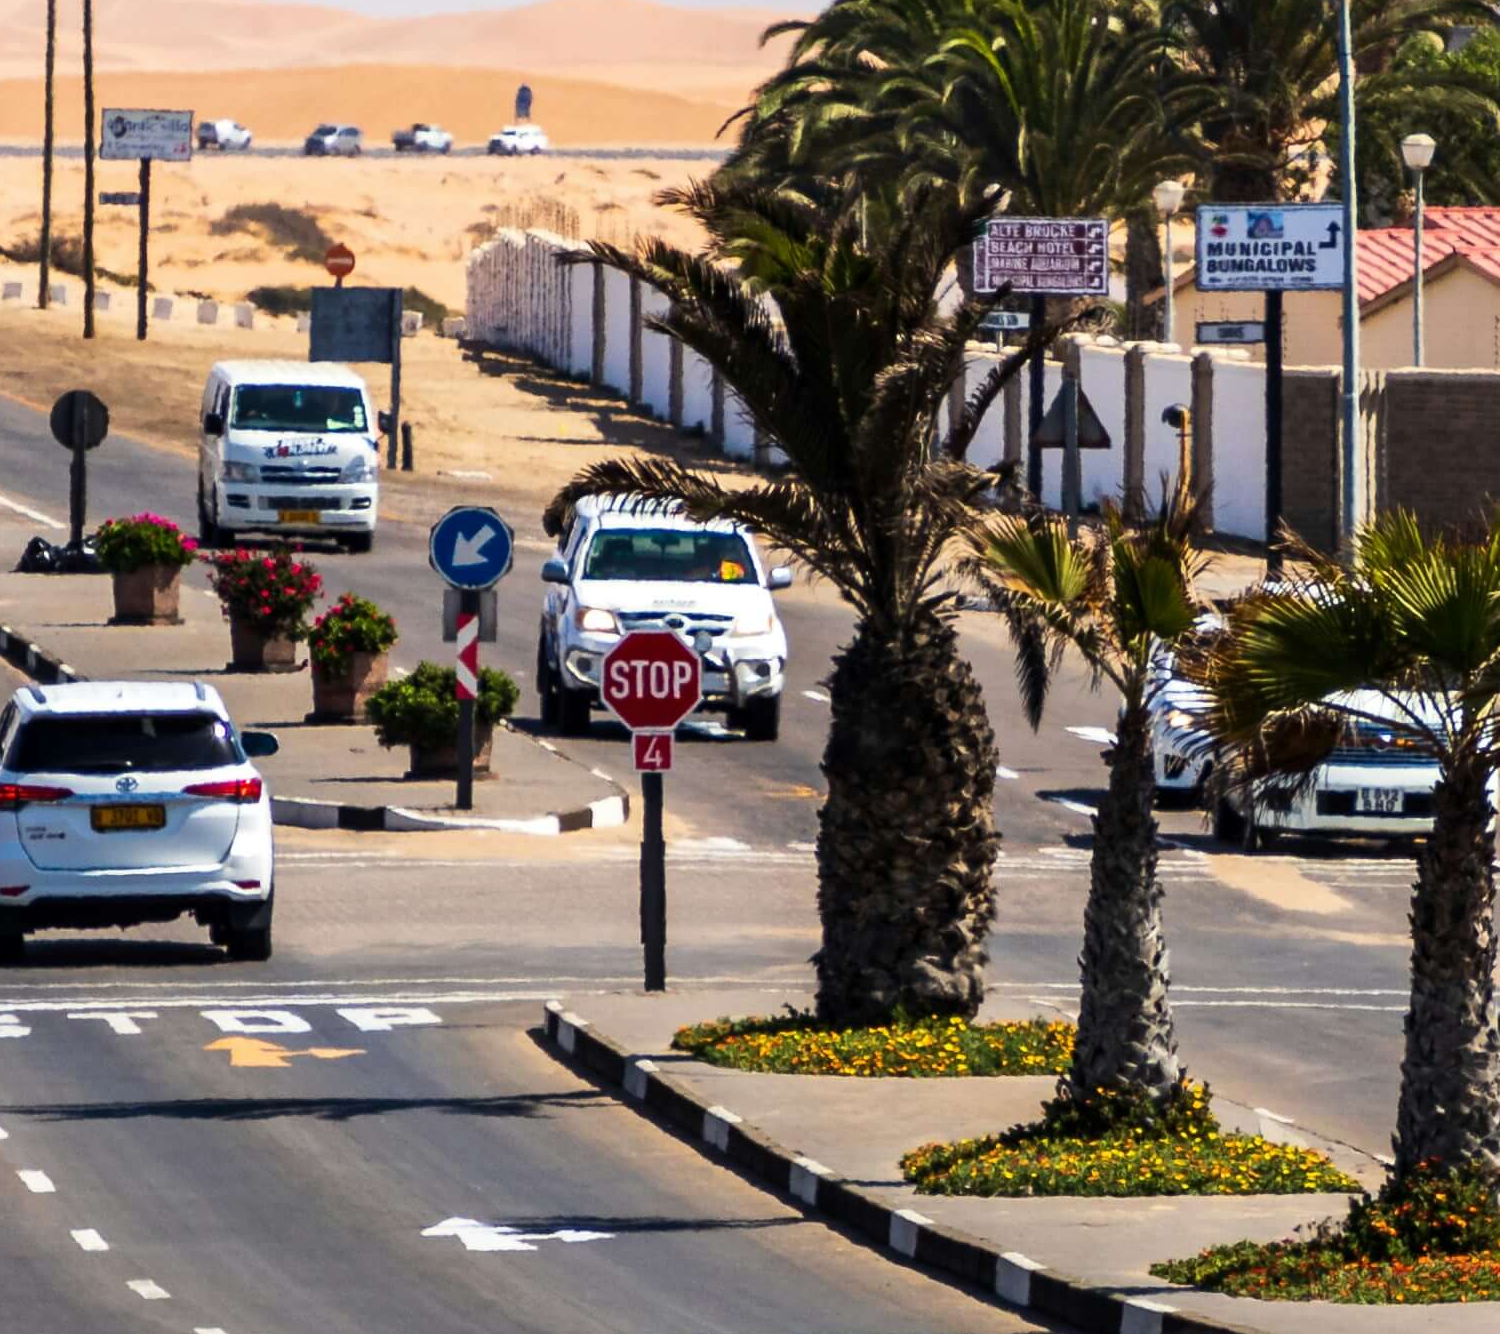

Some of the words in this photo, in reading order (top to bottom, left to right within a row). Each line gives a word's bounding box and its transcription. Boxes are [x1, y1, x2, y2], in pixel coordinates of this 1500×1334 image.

[989, 225, 1021, 237] ALTE
[990, 241, 1033, 253] BEACH
[1037, 241, 1075, 253] HOTEL
[1206, 241, 1317, 257] MUNICIPAL
[1206, 258, 1317, 273] BUNGALOWS
[610, 660, 693, 699] STOP
[643, 737, 662, 767] 4
